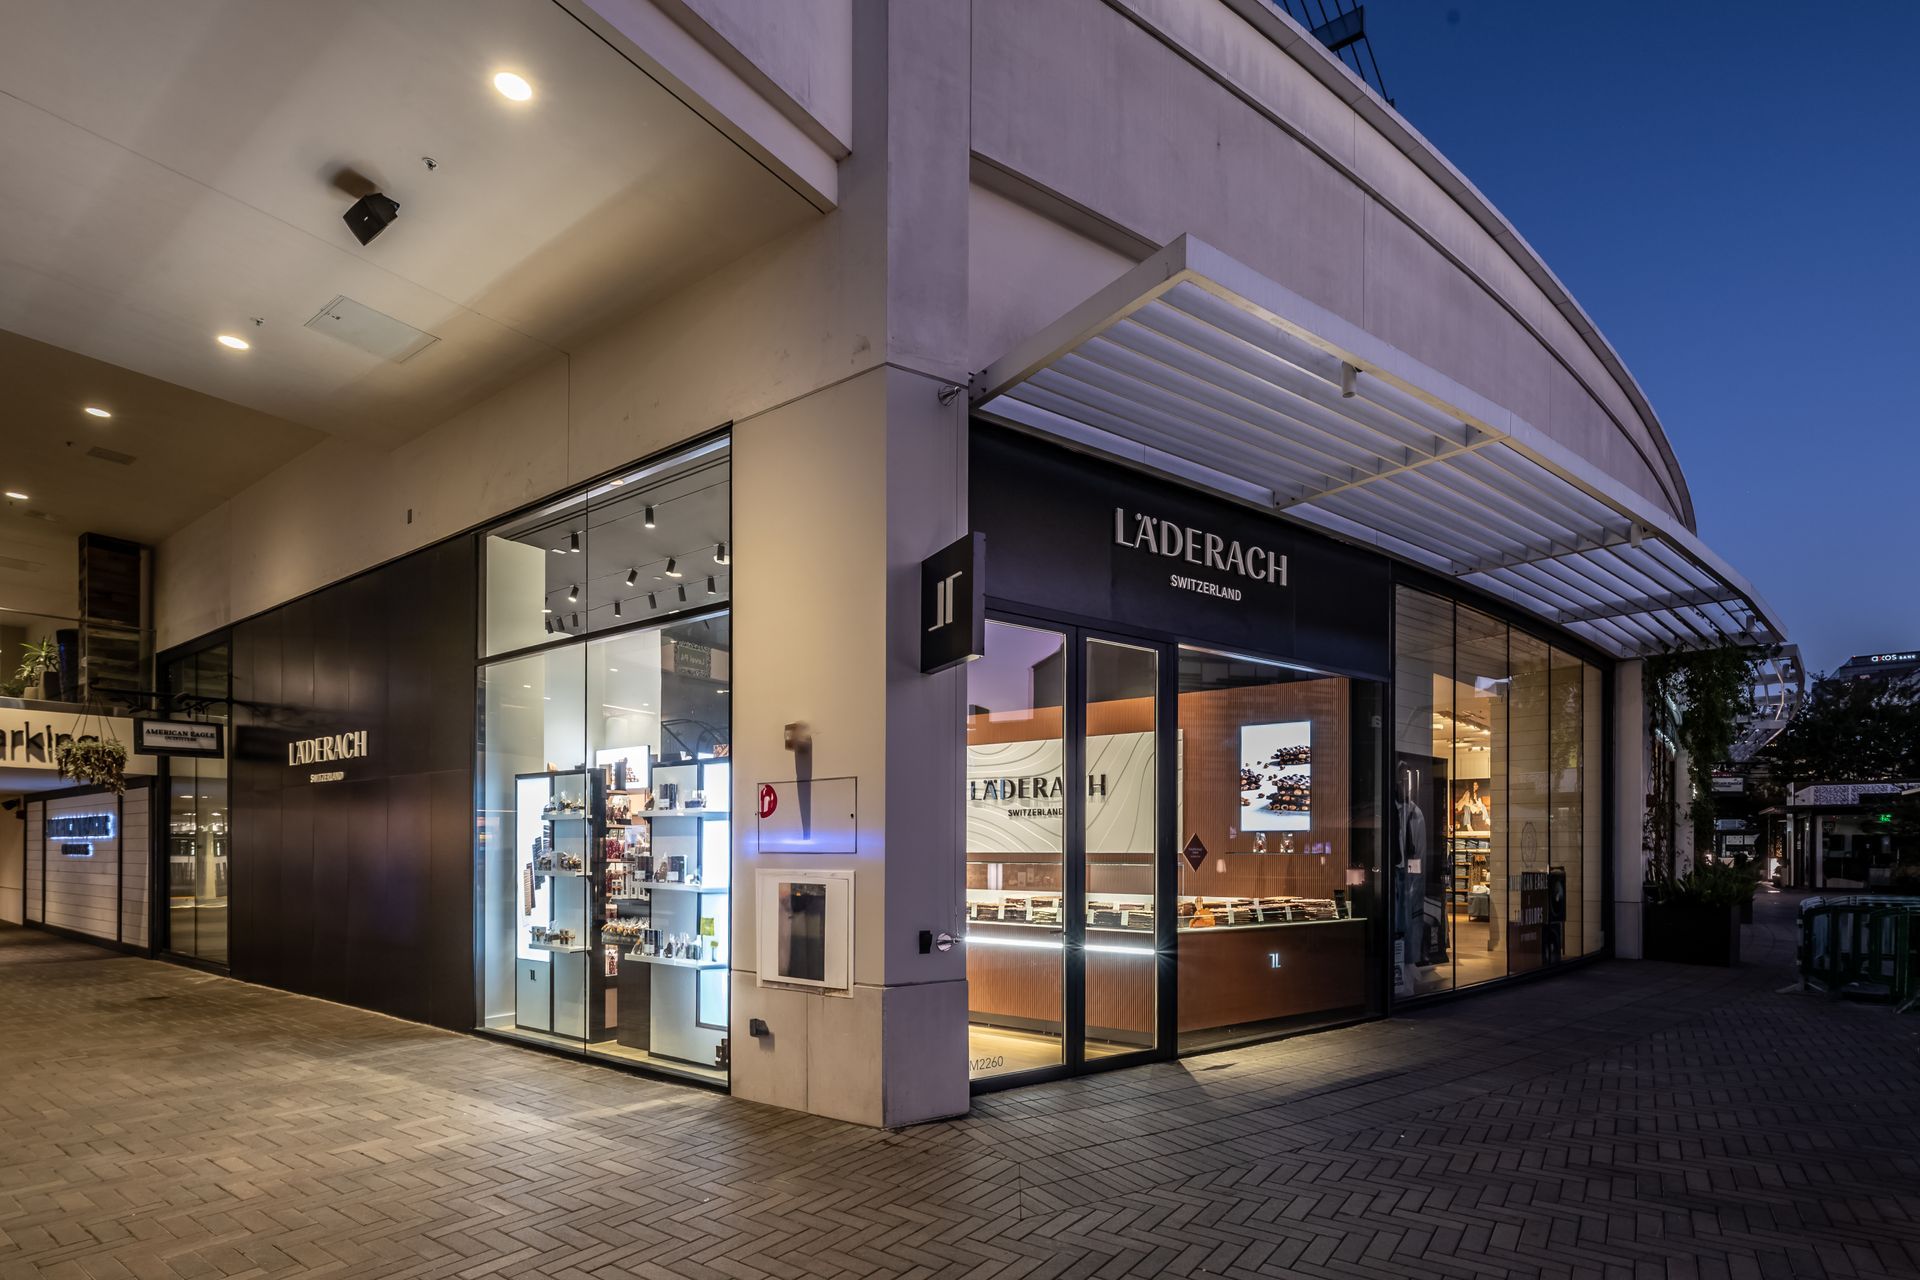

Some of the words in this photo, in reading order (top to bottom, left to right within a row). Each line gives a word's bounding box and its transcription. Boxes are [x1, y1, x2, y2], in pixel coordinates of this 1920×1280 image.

[1115, 507, 1288, 587] LÄDERACH
[1169, 574, 1242, 602] SWITZERLAND
[0, 721, 99, 763] rki
[145, 728, 188, 737] AMERICAN
[190, 730, 216, 739] EAGLE
[288, 730, 368, 766] LÄDERACH
[970, 774, 1107, 801] LÄDERAH
[1008, 807, 1063, 817] SWITZERLAND
[969, 1055, 1004, 1071] M2260
